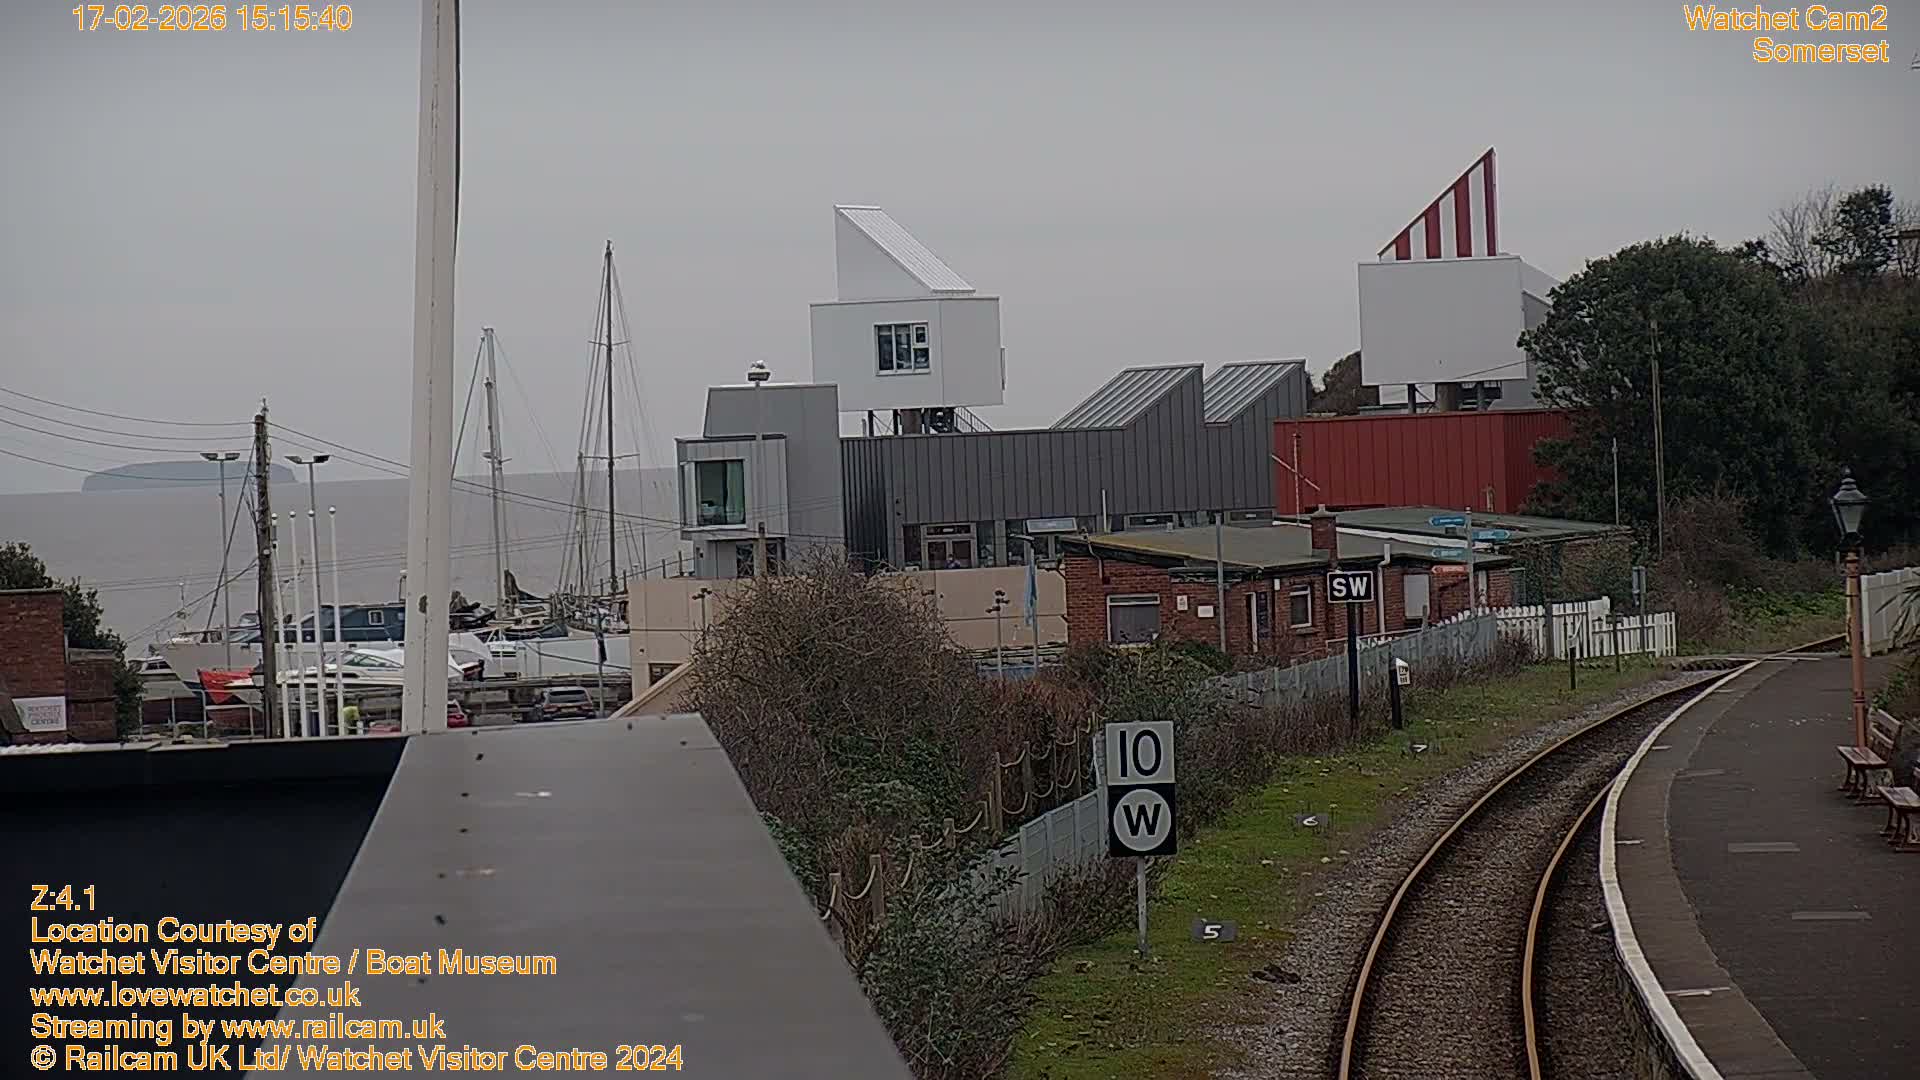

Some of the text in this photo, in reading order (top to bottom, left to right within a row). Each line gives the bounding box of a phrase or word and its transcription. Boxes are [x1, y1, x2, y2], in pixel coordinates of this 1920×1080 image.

[1332, 576, 1368, 598] SW
[1119, 729, 1162, 778] 10
[1122, 802, 1162, 837] W
[1302, 815, 1319, 826] 6
[1202, 924, 1223, 940] 5
